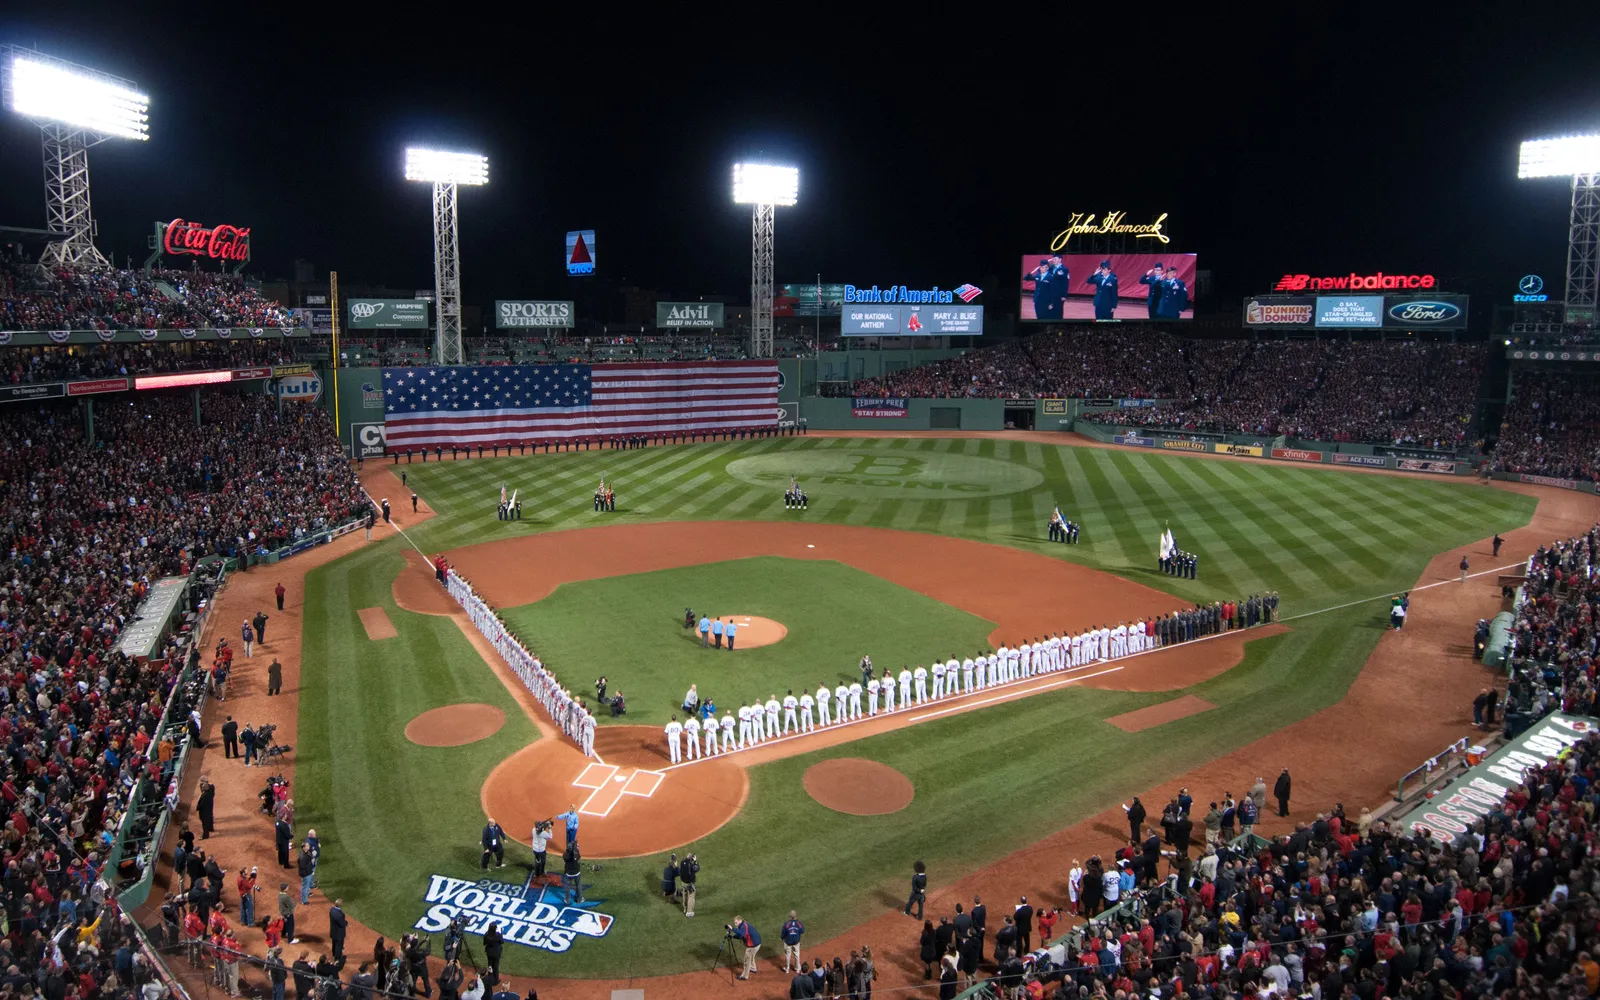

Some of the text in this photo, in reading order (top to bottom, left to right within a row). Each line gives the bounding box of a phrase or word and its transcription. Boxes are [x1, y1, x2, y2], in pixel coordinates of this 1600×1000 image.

[1051, 210, 1170, 251] John Hancock
[164, 218, 250, 261] Coca-Cola
[569, 263, 593, 274] CITGO
[1310, 276, 1350, 289] new
[1350, 272, 1435, 289] balance
[844, 284, 953, 303] Bank of America
[353, 303, 374, 314] AAA
[501, 303, 569, 317] SPORTS
[667, 305, 709, 319] Advil
[1264, 305, 1312, 314] DUNKIN'
[1401, 304, 1445, 320] Ford
[502, 317, 569, 326] AUTHORITY
[933, 312, 951, 320] MARY
[959, 312, 977, 320] BLIGE
[1264, 313, 1311, 323] DONUTS
[860, 321, 885, 329] ANTHEM
[268, 381, 319, 394] Gulf
[1123, 436, 1145, 445] jetBlue
[1191, 442, 1205, 450] CITY
[1283, 450, 1310, 460] xfinity
[1349, 456, 1362, 464] ACE
[1363, 457, 1384, 465] TICKET
[1410, 777, 1508, 843] BOSTON
[1109, 876, 1120, 885] 23
[474, 879, 523, 898] 2013
[425, 875, 558, 926] WORLD
[414, 904, 577, 952] SERIES
